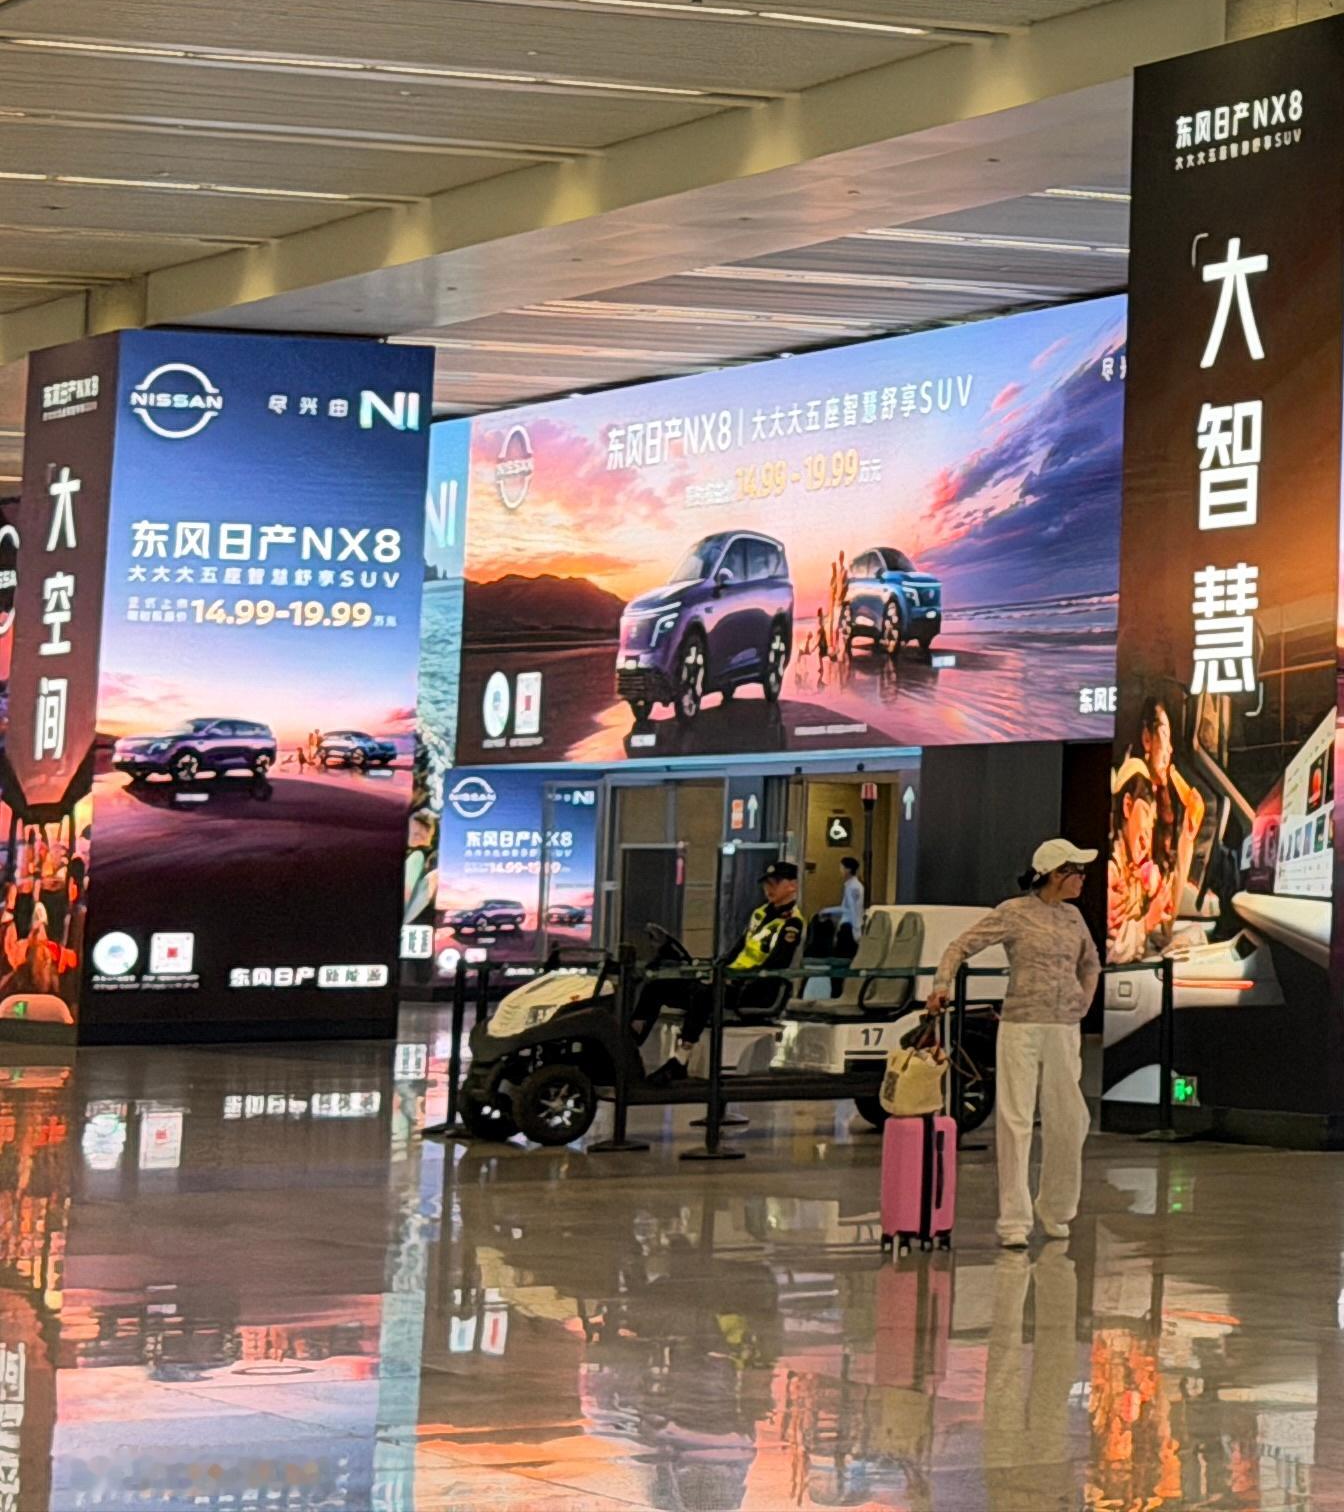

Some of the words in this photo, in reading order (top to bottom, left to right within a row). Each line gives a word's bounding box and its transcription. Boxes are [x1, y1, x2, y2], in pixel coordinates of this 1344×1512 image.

[1175, 89, 1303, 149] 东风日产NX8
[130, 392, 222, 410] NISSAN
[606, 409, 732, 471] 东风日产NX8
[751, 374, 974, 441] 大大大五座智慧舒享SUV
[1191, 237, 1268, 695] 大智慧
[131, 520, 401, 562] 东风日产NX8
[34, 466, 81, 761] 大空间
[190, 599, 372, 627] 14.99-19.99
[861, 1028, 884, 1046] 17
